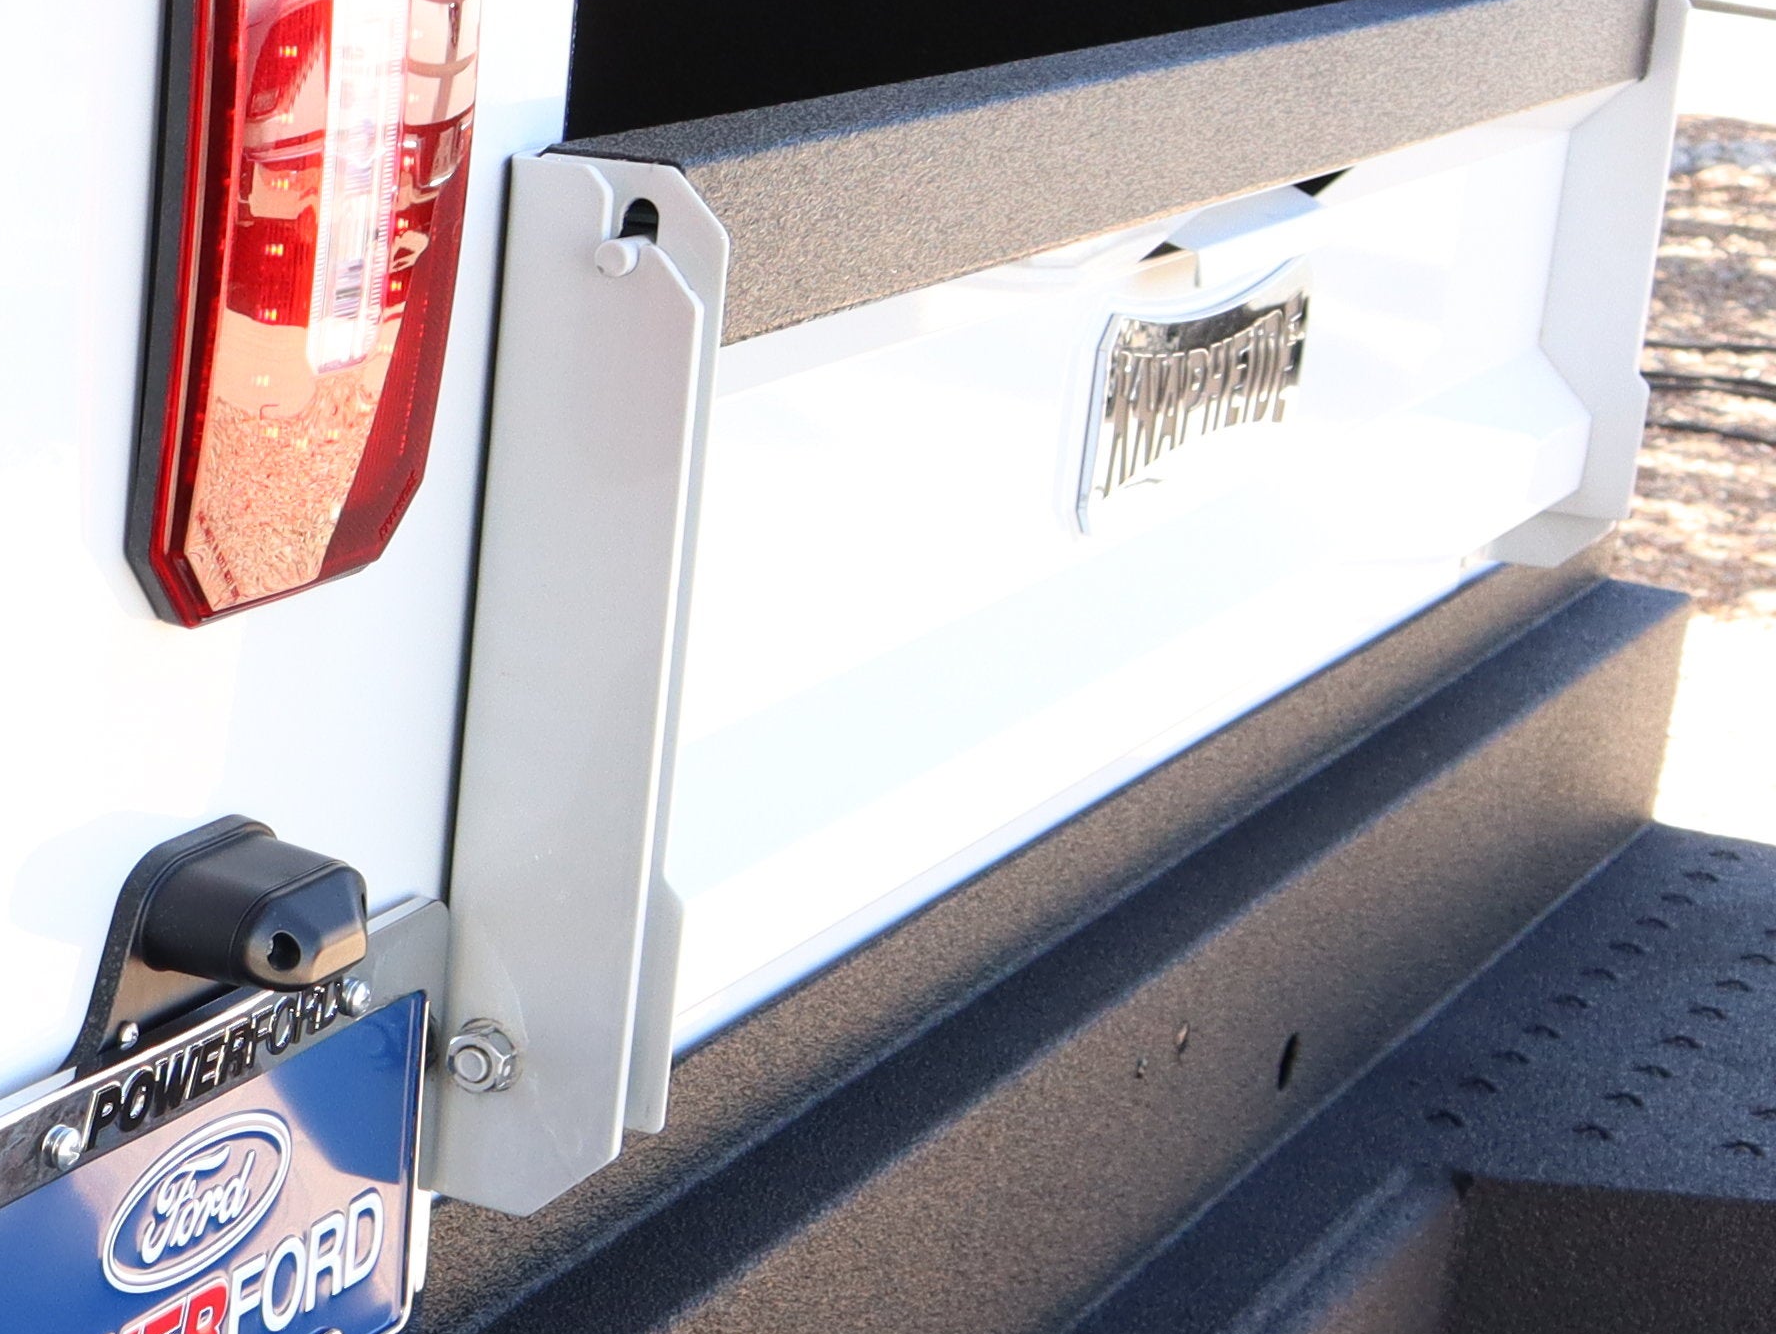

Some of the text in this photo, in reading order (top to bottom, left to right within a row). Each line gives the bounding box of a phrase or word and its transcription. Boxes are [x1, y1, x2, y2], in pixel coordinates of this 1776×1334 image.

[1102, 289, 1306, 501] KNAPHEIDE
[81, 976, 346, 1153] POWERFORD
[141, 1143, 257, 1264] Ford
